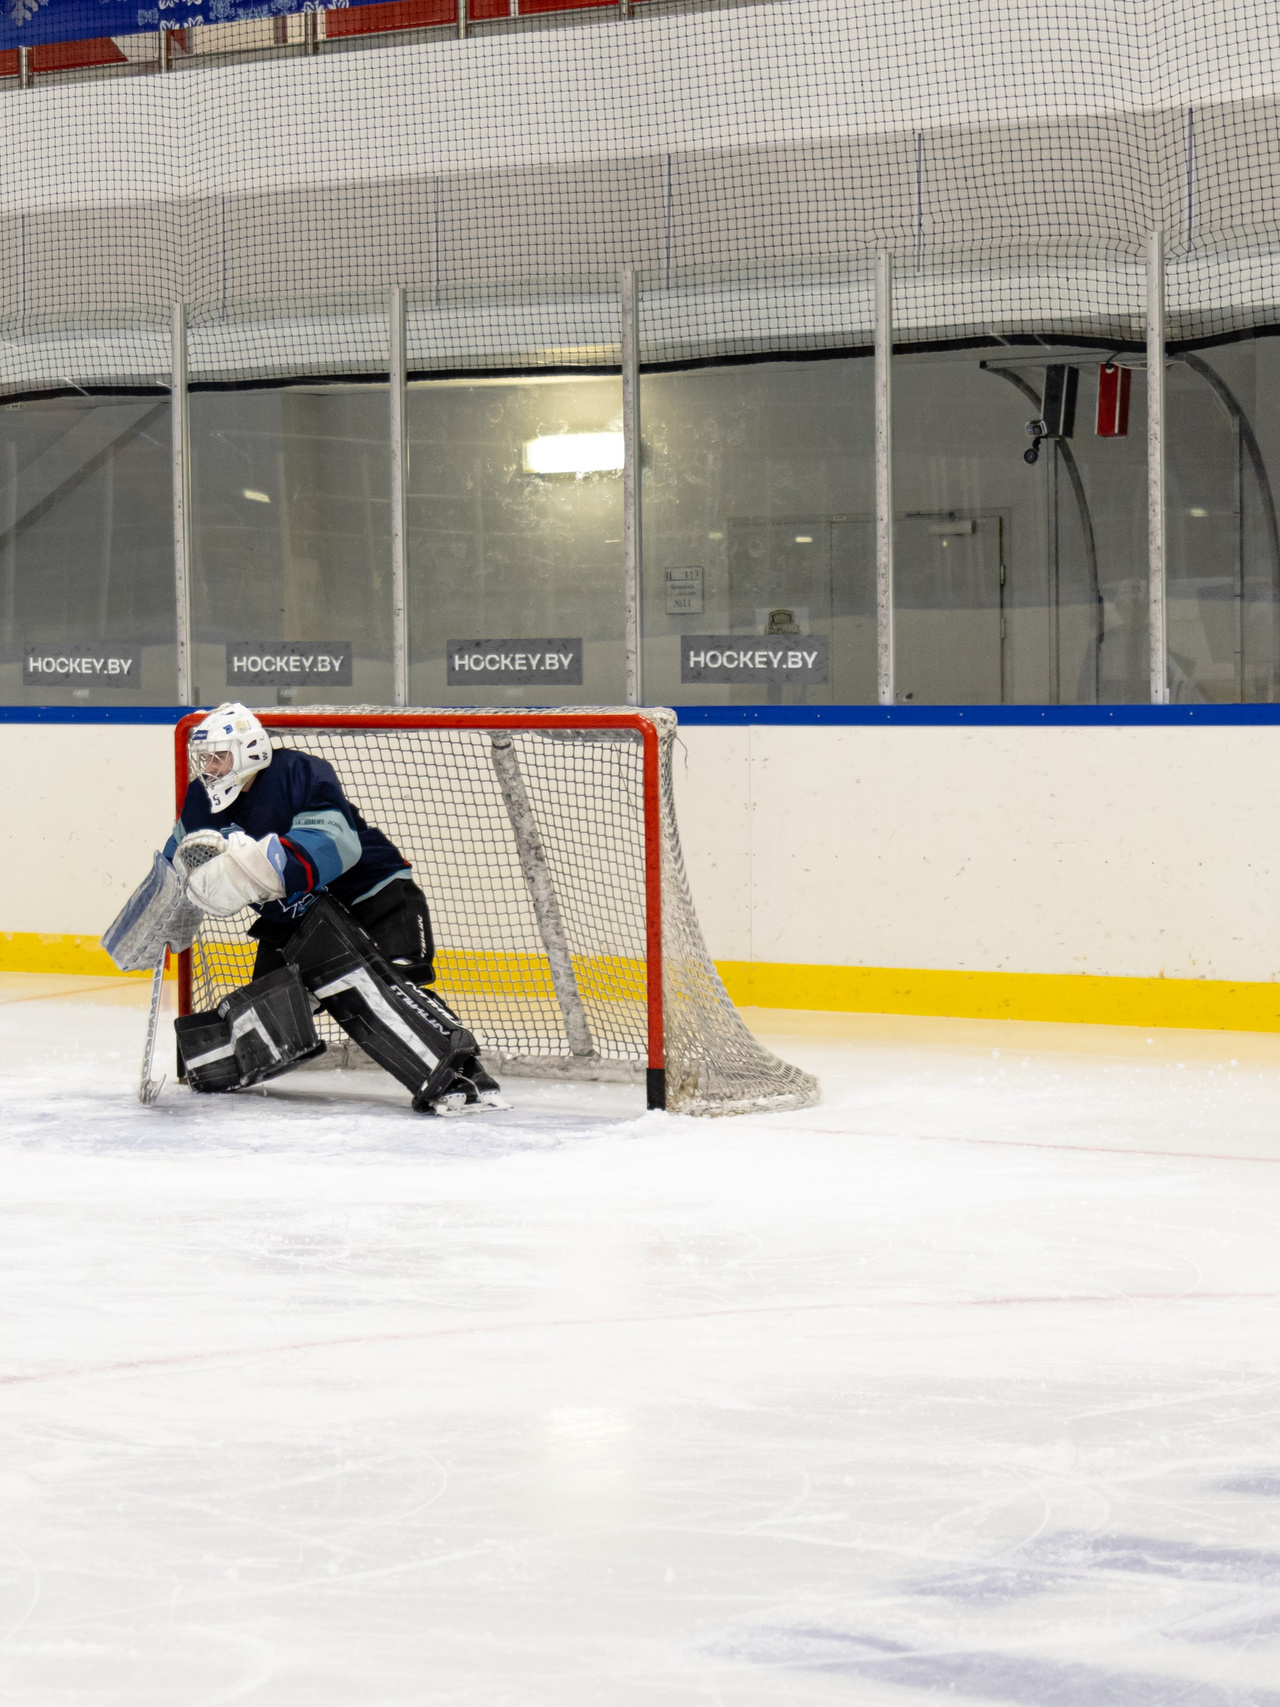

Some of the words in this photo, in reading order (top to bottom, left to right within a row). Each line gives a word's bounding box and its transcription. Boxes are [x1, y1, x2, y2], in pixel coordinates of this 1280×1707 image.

[28, 657, 133, 674] HOCKEY.BY
[233, 655, 345, 672] HOCKEY.BY
[454, 653, 574, 671] HOCKEY.BY
[689, 651, 819, 669] HOCKEY.BY
[141, 957, 164, 1082] HERWOO
